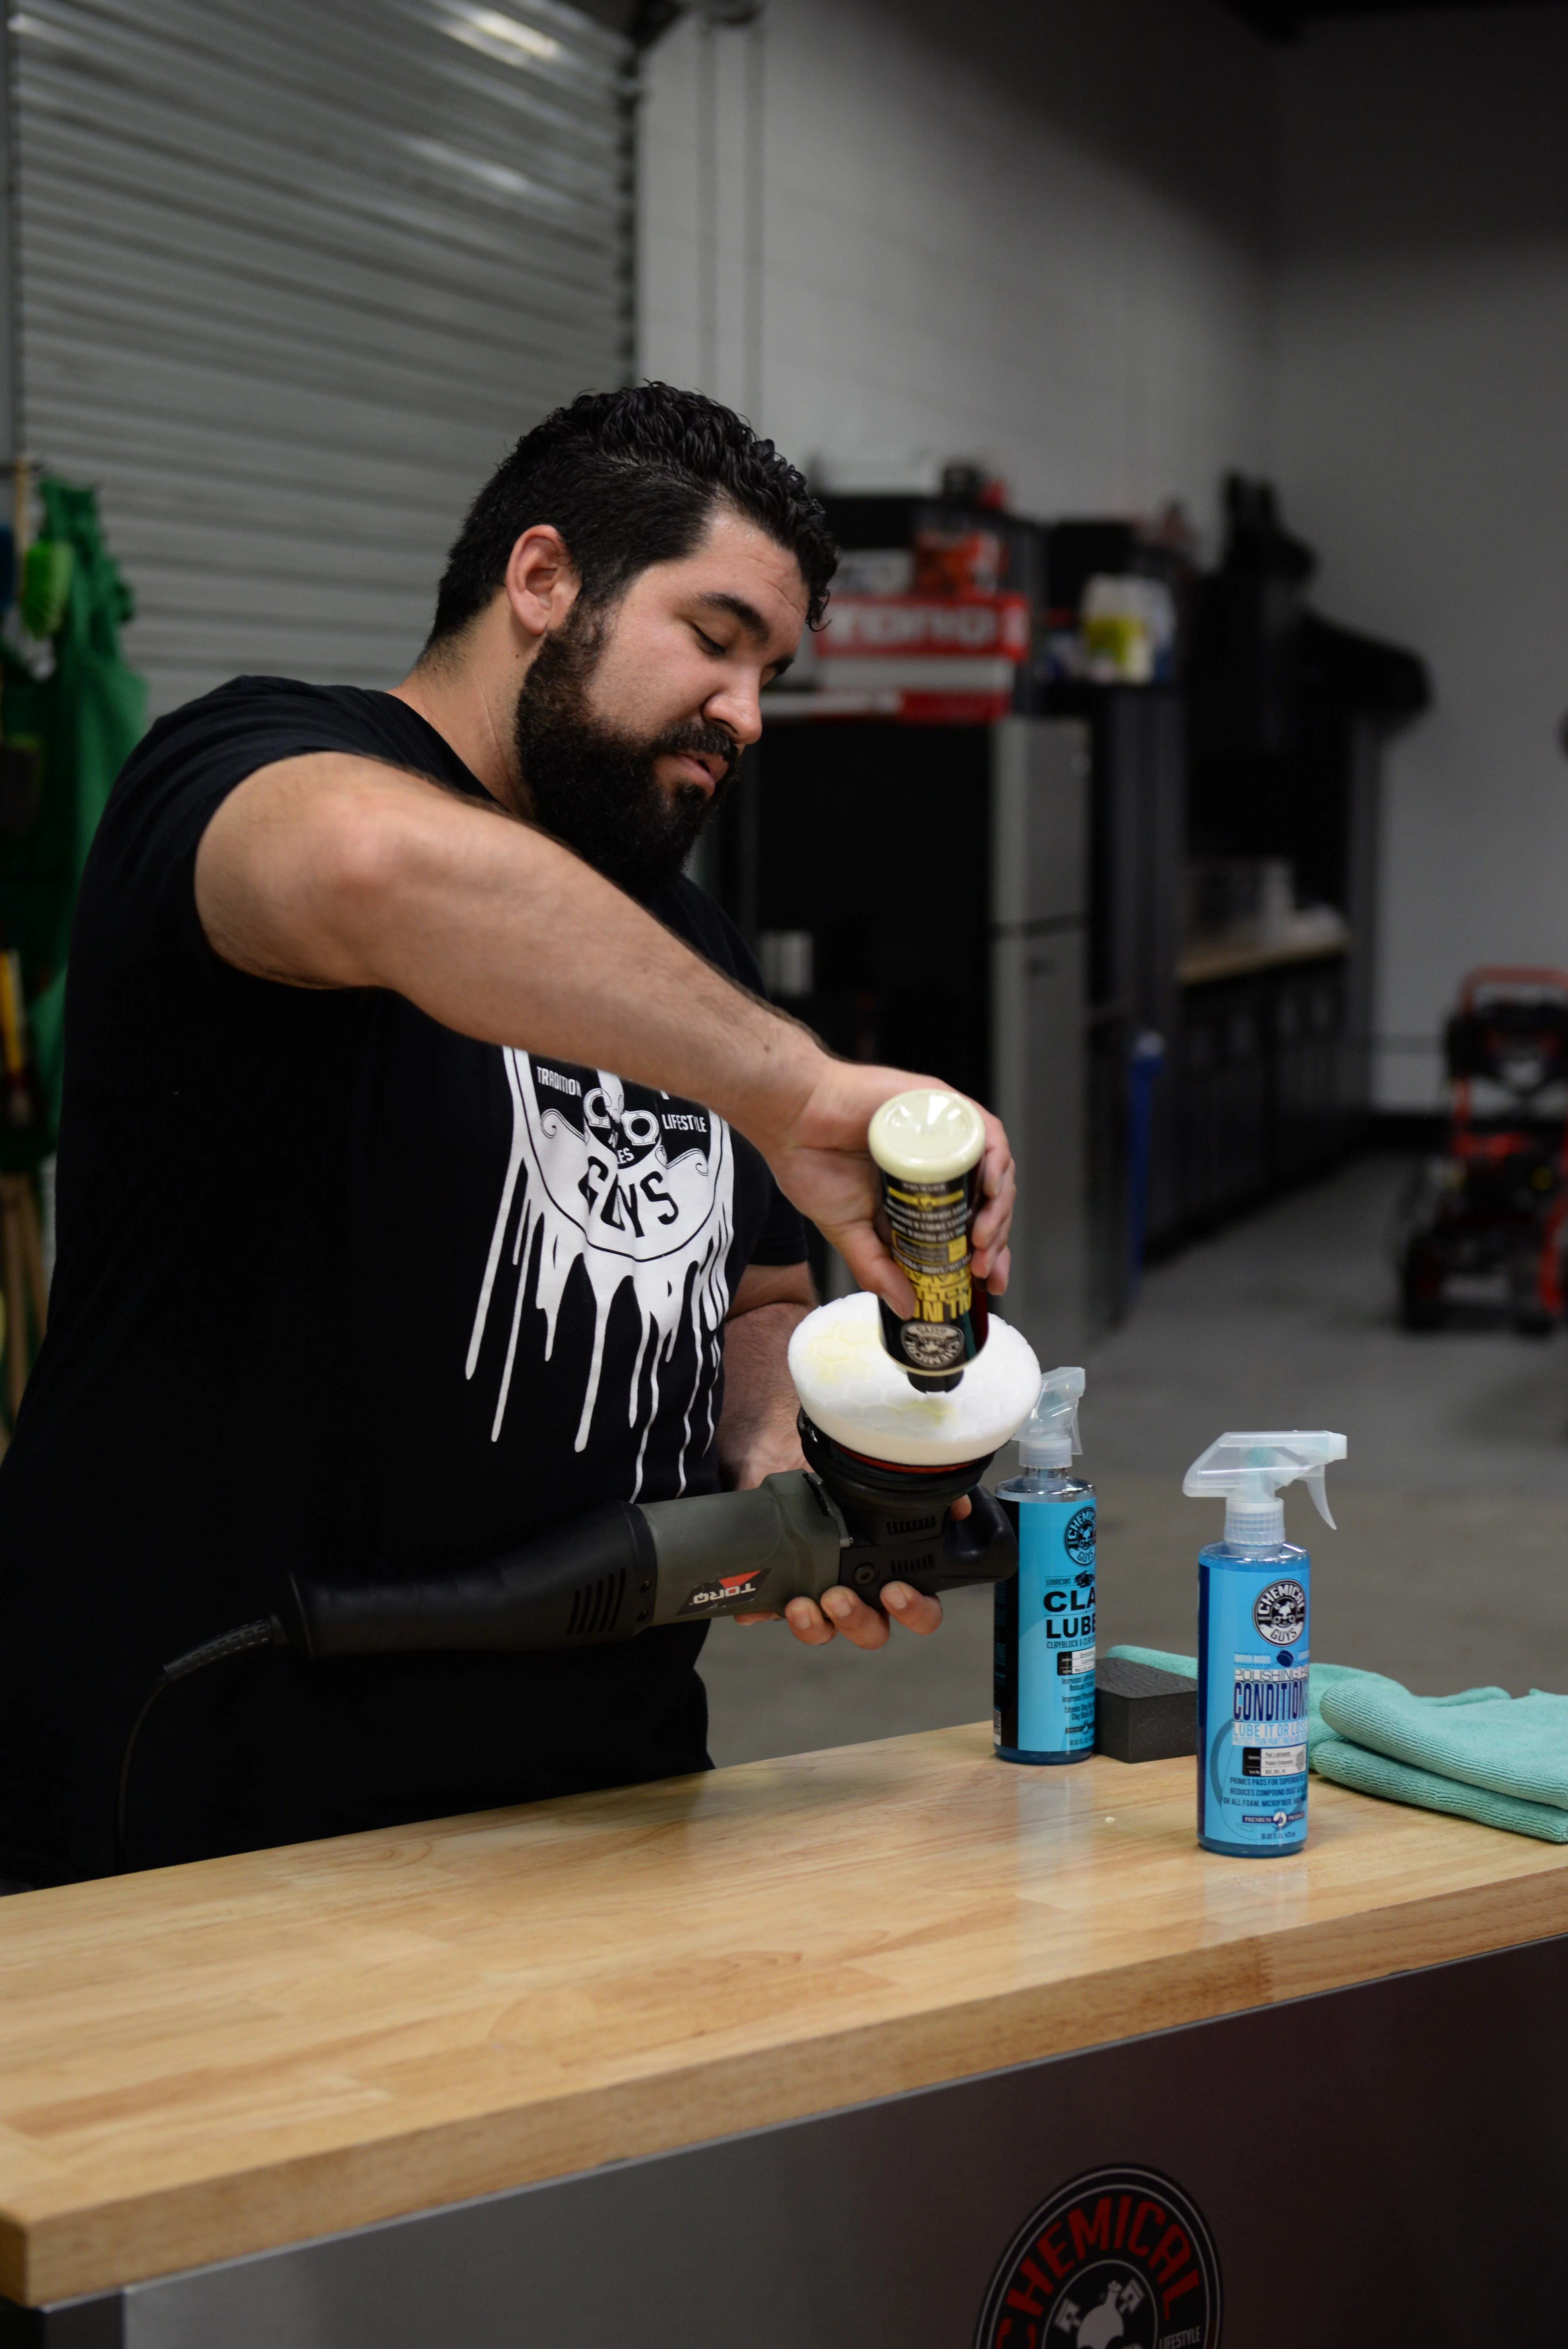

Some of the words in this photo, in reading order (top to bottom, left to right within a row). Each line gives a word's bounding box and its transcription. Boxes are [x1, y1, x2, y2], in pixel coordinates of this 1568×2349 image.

[536, 1066, 582, 1097] TRADITION
[661, 1114, 707, 1132] LIFESTLE
[693, 1583, 756, 1604] TORQ
[1258, 1584, 1305, 1614] CHEMICAL
[1270, 1629, 1297, 1641] GUYS
[1235, 1668, 1299, 1681] POLISHING
[1233, 1722, 1260, 1737] LUBE
[1265, 1724, 1274, 1737] IT
[1278, 1723, 1289, 1736] OR
[1230, 1777, 1251, 1785] PRIMES
[1230, 1787, 1254, 1796] REDUCES
[1256, 1788, 1285, 1797] COMPOUND
[996, 2196, 1199, 2349] CHEMICAL
